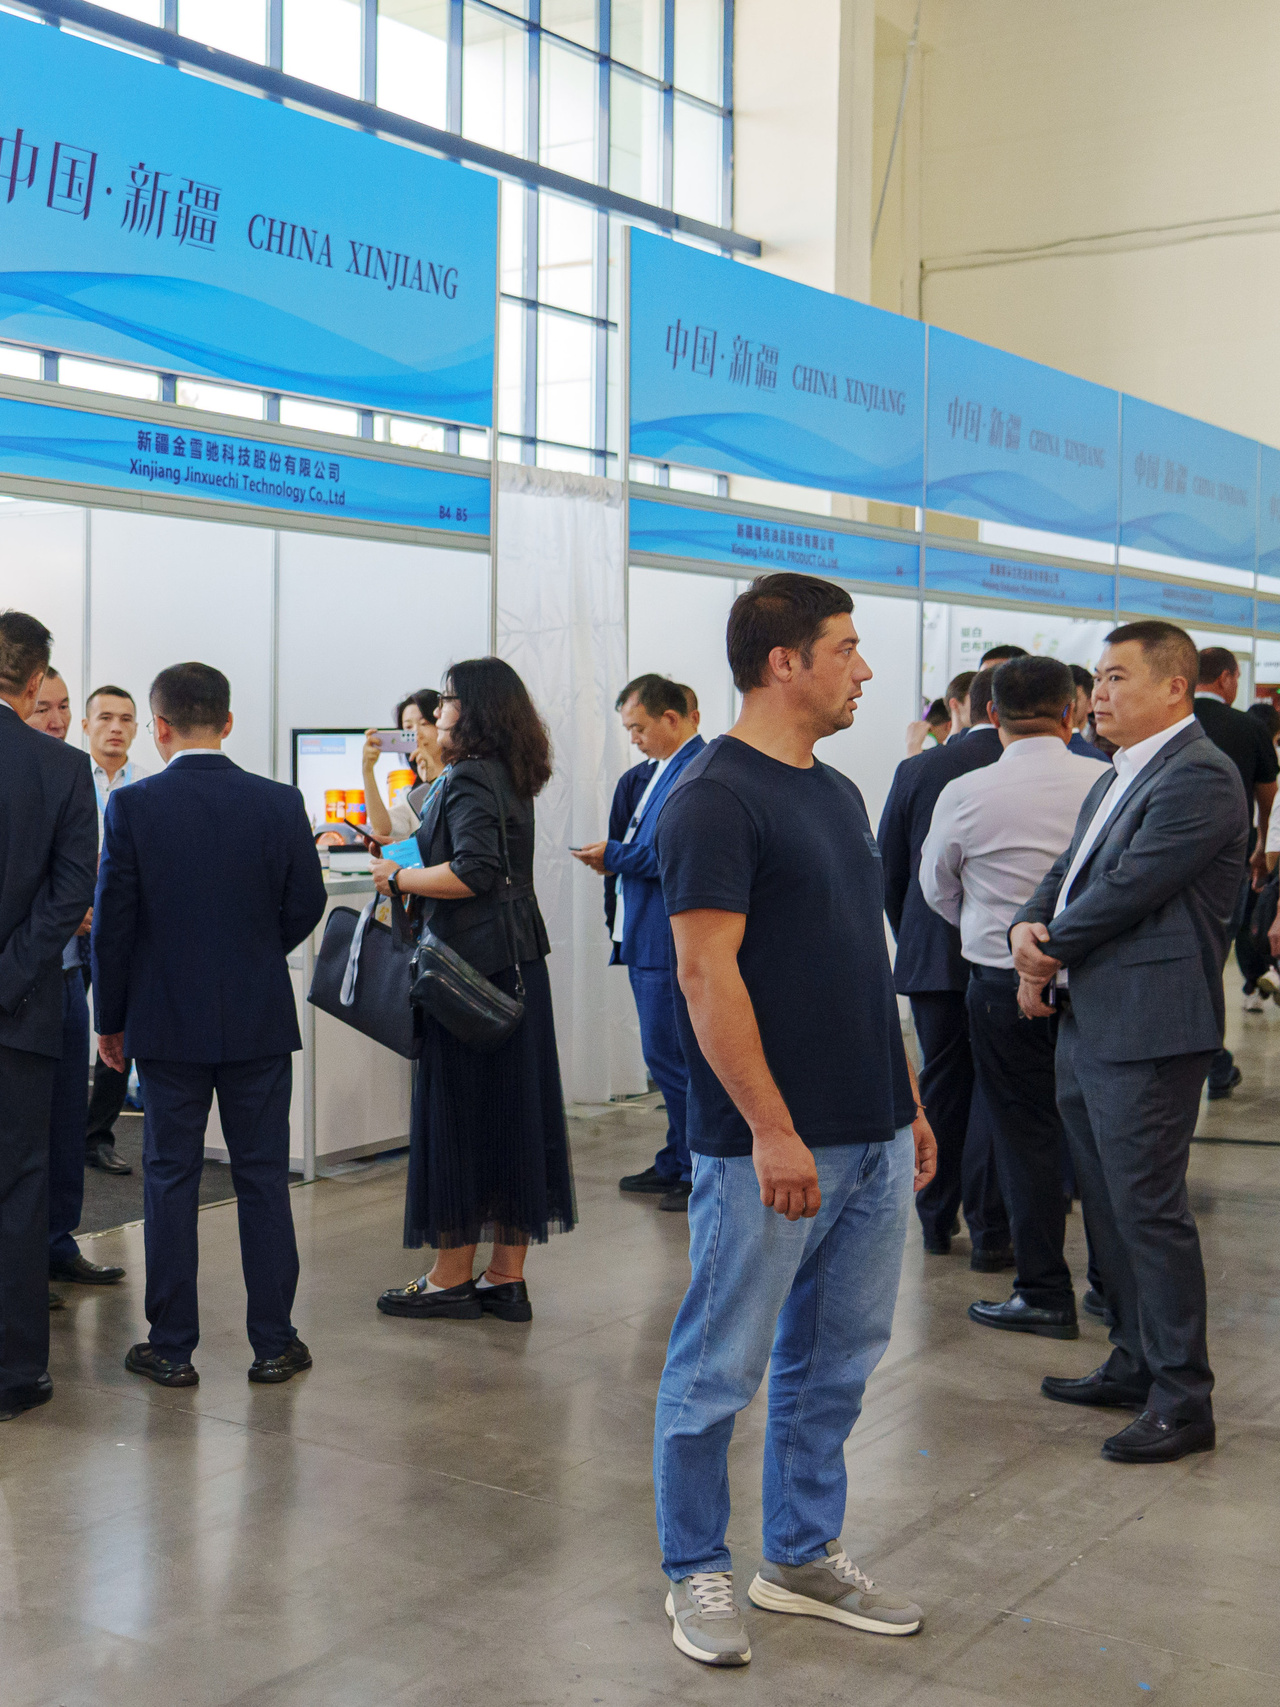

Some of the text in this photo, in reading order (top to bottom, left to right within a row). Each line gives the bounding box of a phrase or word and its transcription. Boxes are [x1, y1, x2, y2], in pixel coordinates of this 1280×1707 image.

[247, 213, 333, 268] CHINA
[345, 239, 459, 300] XINJIANG
[665, 317, 906, 416] 中国·新疆 CHINA XINJIANG
[136, 429, 341, 482] 新疆金雪驰科技股份有限公司
[130, 458, 346, 507] Xinjiang Jinxuechi Technology Co.,Ltd
[438, 505, 469, 523] B4 B5
